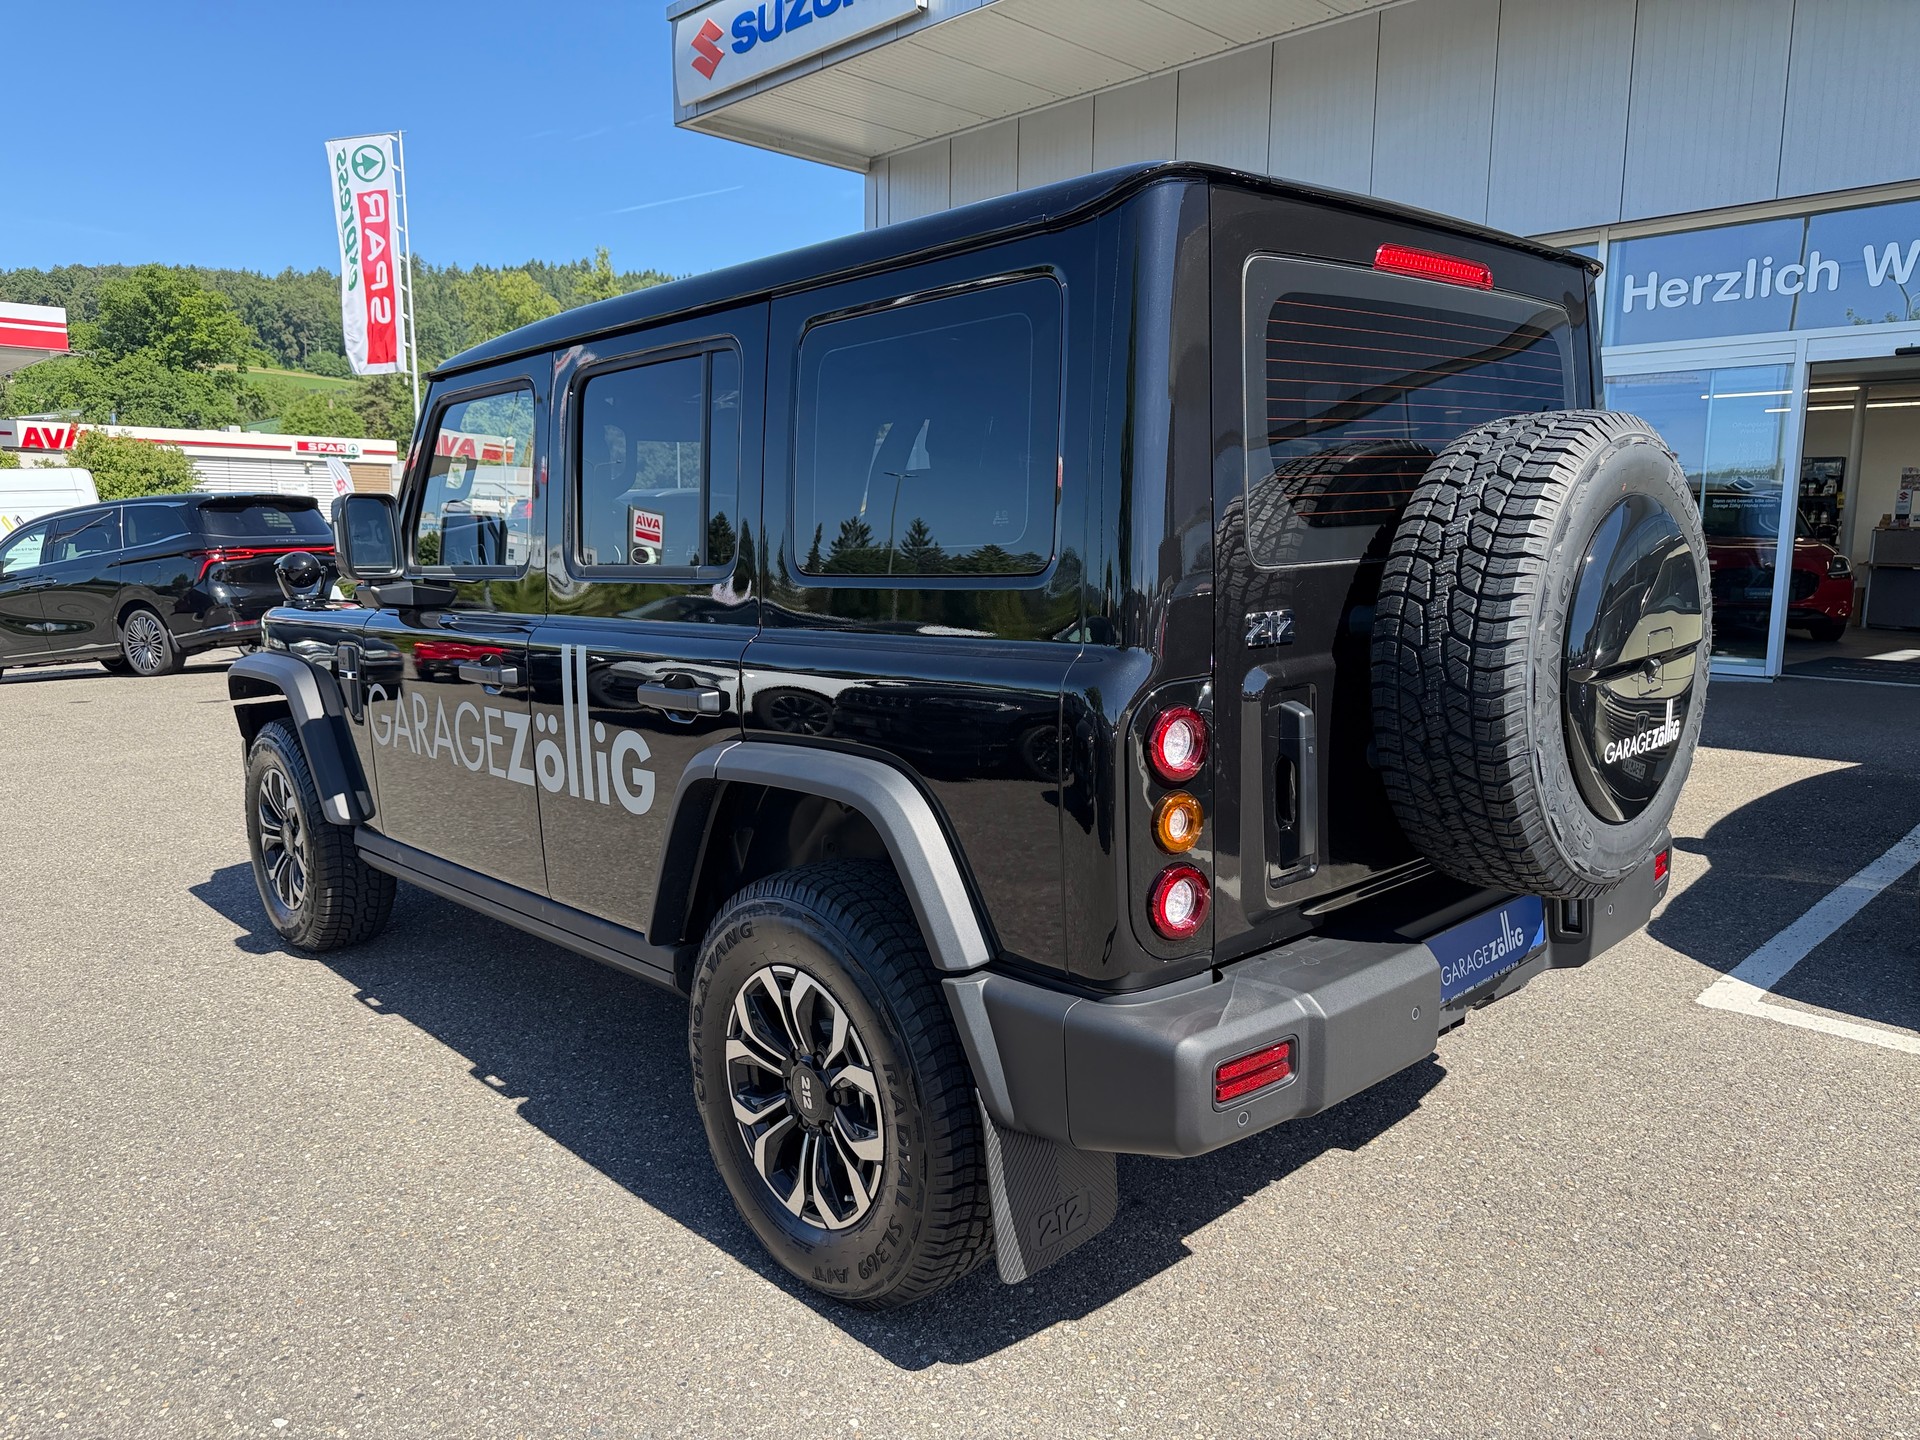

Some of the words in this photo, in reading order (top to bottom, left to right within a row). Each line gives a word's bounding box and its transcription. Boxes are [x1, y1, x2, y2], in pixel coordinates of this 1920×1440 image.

[731, 0, 854, 54] SUZ
[1622, 250, 1841, 313] Herzlich
[307, 442, 346, 452] SPAR
[1245, 608, 1296, 647] 212
[704, 920, 755, 975] YANG
[800, 1075, 813, 1110] 212
[1037, 1194, 1084, 1247] 212
